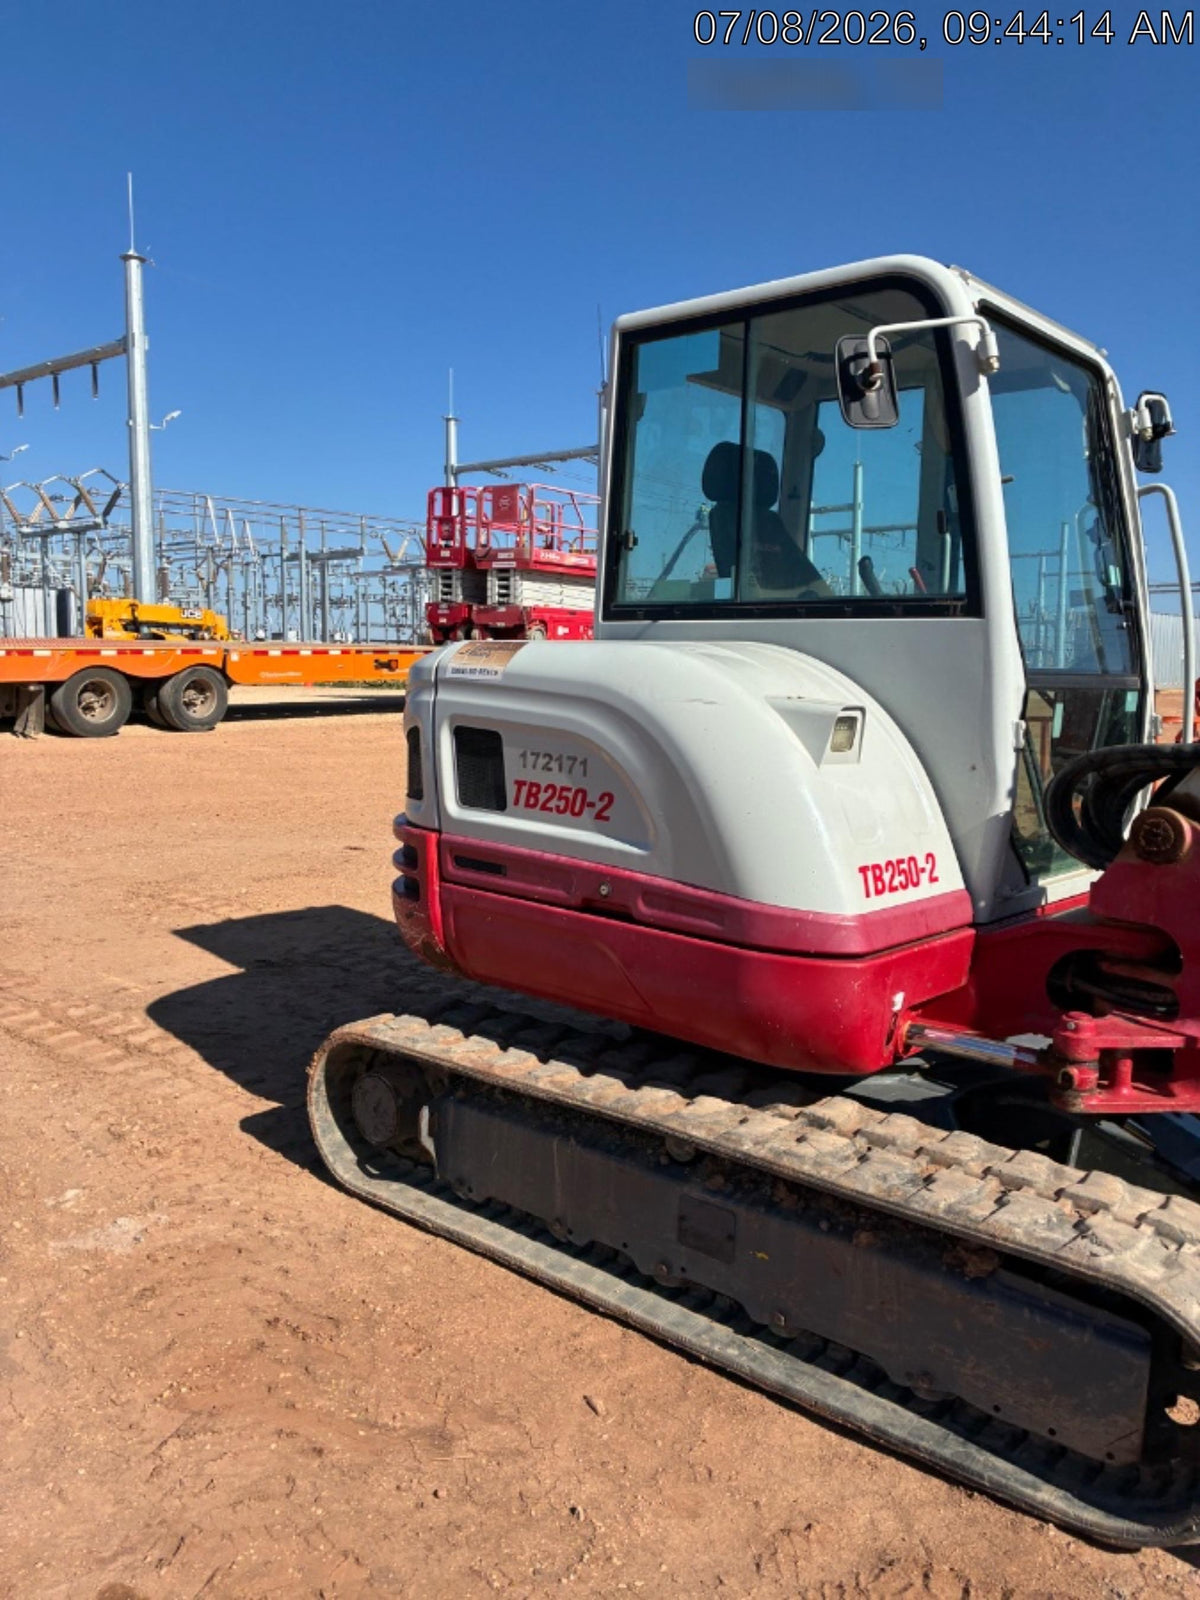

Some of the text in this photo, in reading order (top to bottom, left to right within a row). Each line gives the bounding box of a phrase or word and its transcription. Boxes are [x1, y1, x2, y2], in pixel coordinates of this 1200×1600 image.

[520, 750, 588, 777] 172171
[513, 779, 615, 822] TB250-2
[858, 852, 939, 898] TB250-2
